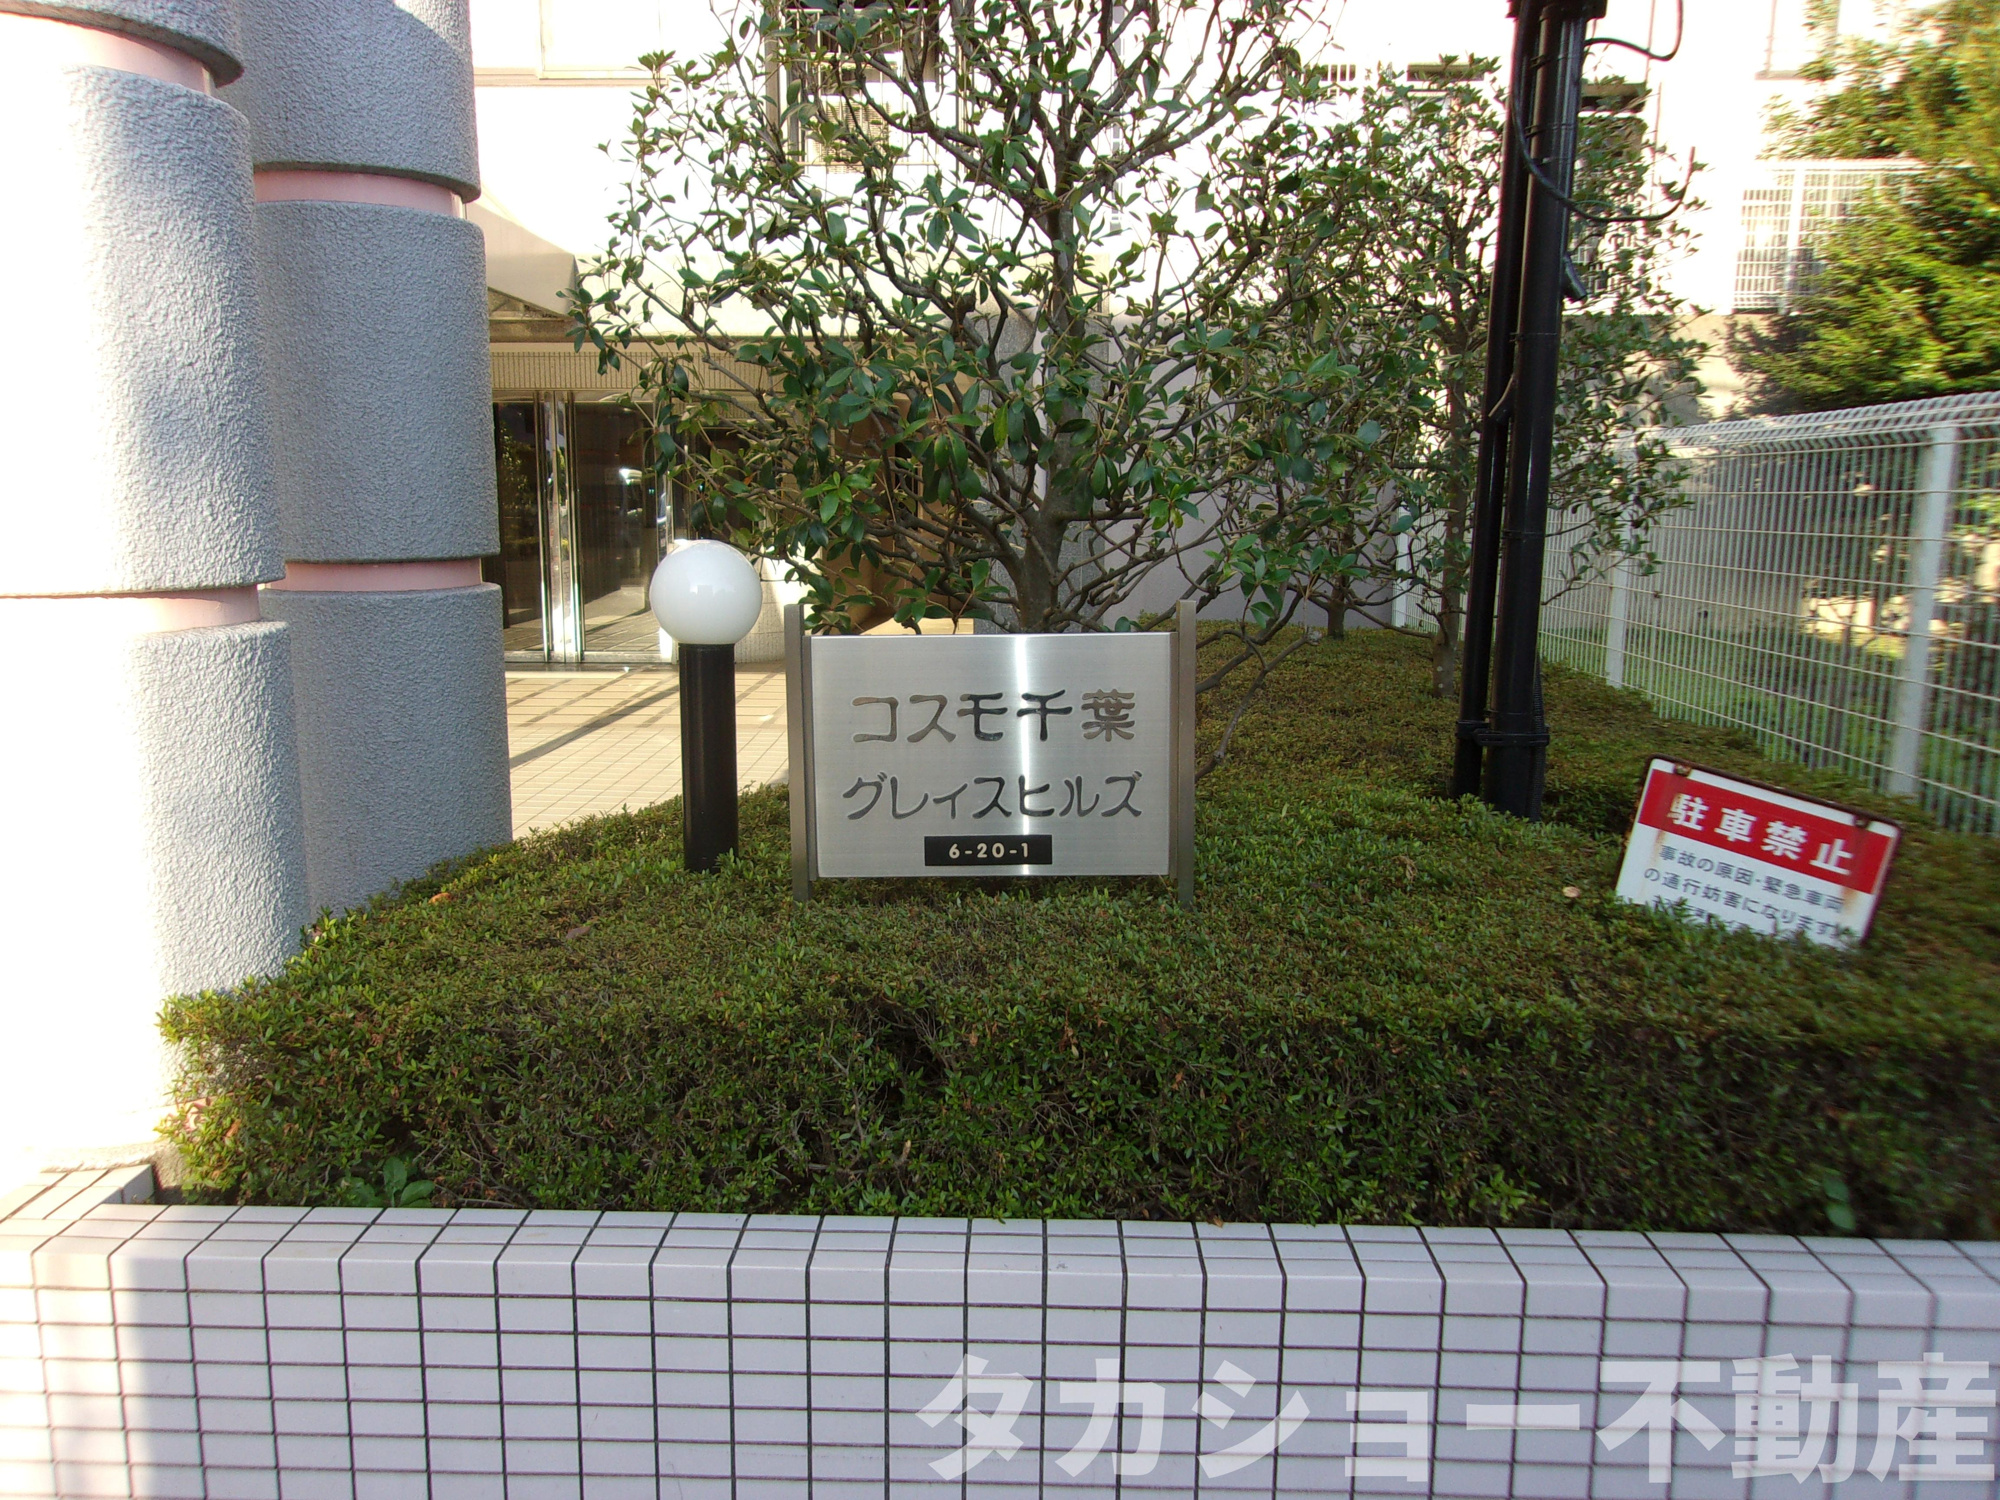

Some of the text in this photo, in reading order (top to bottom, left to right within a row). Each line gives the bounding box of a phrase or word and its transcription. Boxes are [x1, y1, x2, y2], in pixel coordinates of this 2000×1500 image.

[852, 688, 1136, 742] コスモ千葉
[842, 770, 1142, 820] グレイスヒルズ
[948, 842, 1029, 860] 6-20-1
[1667, 793, 1854, 876] 駐車禁止
